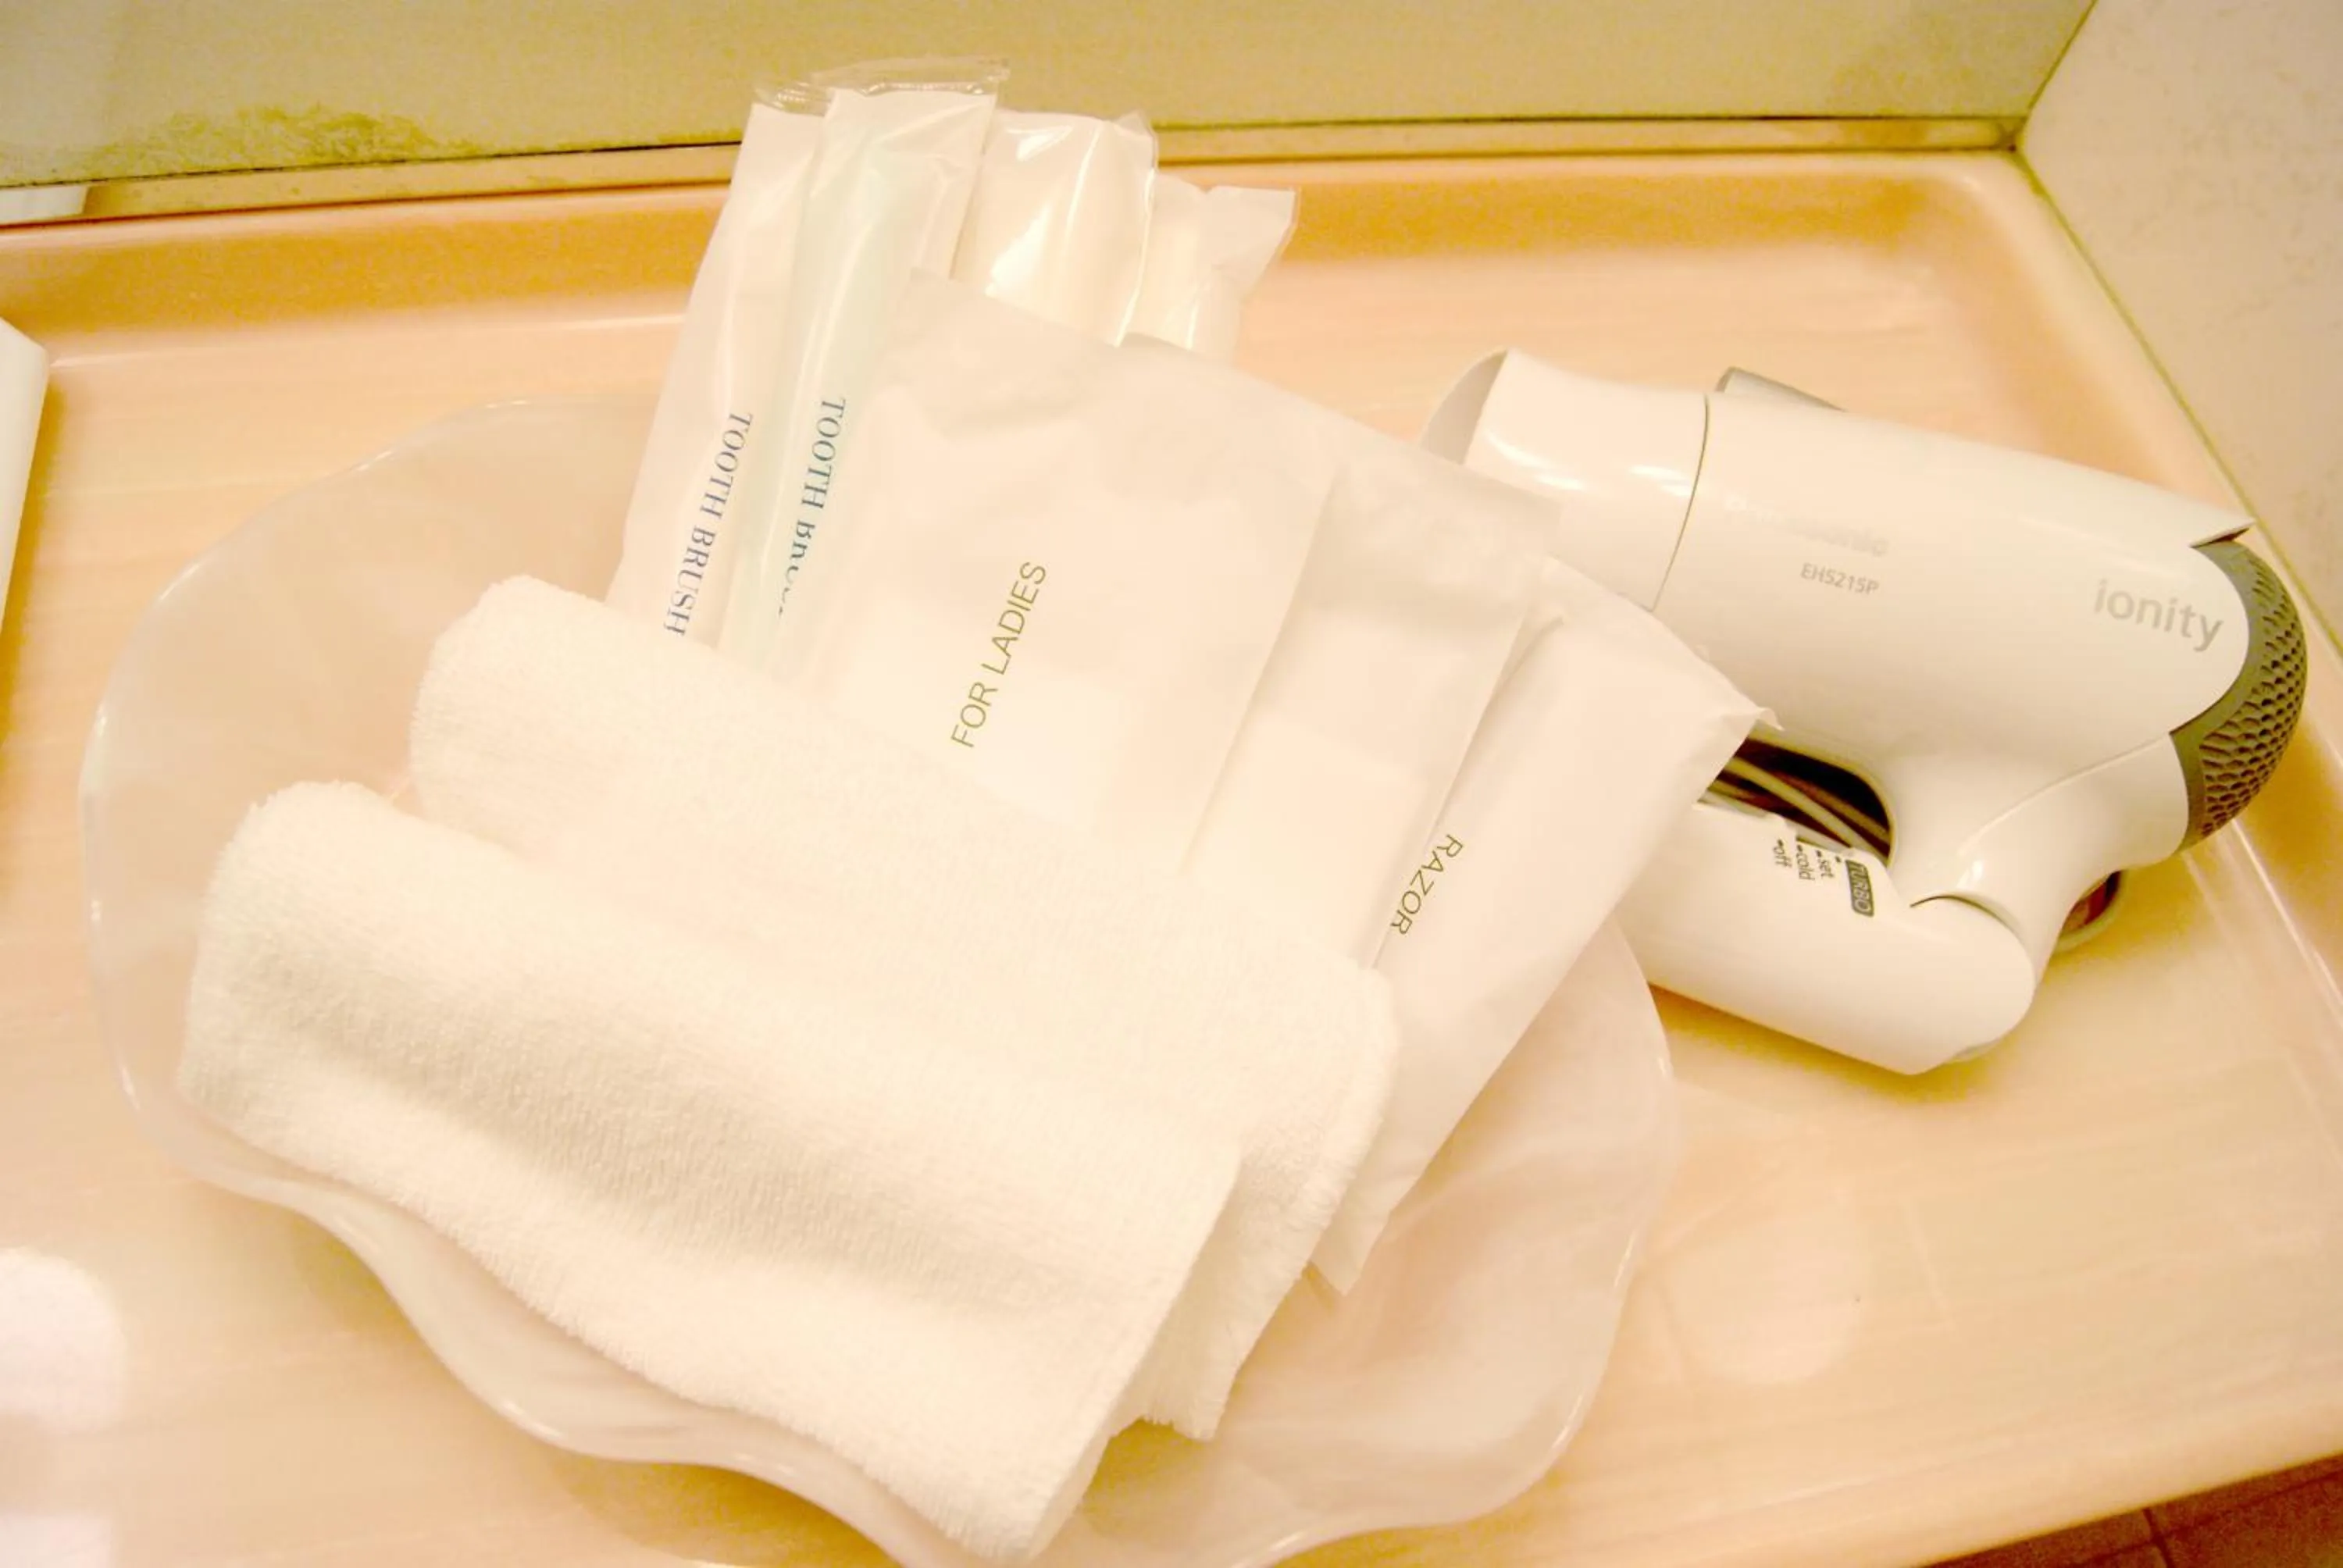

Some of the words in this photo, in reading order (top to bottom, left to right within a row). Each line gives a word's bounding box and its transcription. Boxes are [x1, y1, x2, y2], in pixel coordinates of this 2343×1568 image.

[699, 412, 753, 520] TOOTH
[801, 397, 847, 509] TOOTH
[664, 526, 716, 636] BRUSH
[2094, 578, 2224, 653] ionity
[950, 681, 999, 748] FOR
[981, 561, 1047, 675] LADIES
[1390, 834, 1464, 935] RAZOR
[1772, 846, 1792, 868] off
[1796, 852, 1816, 881] cold
[1819, 858, 1835, 878] set
[1848, 862, 1872, 913] TURBO
